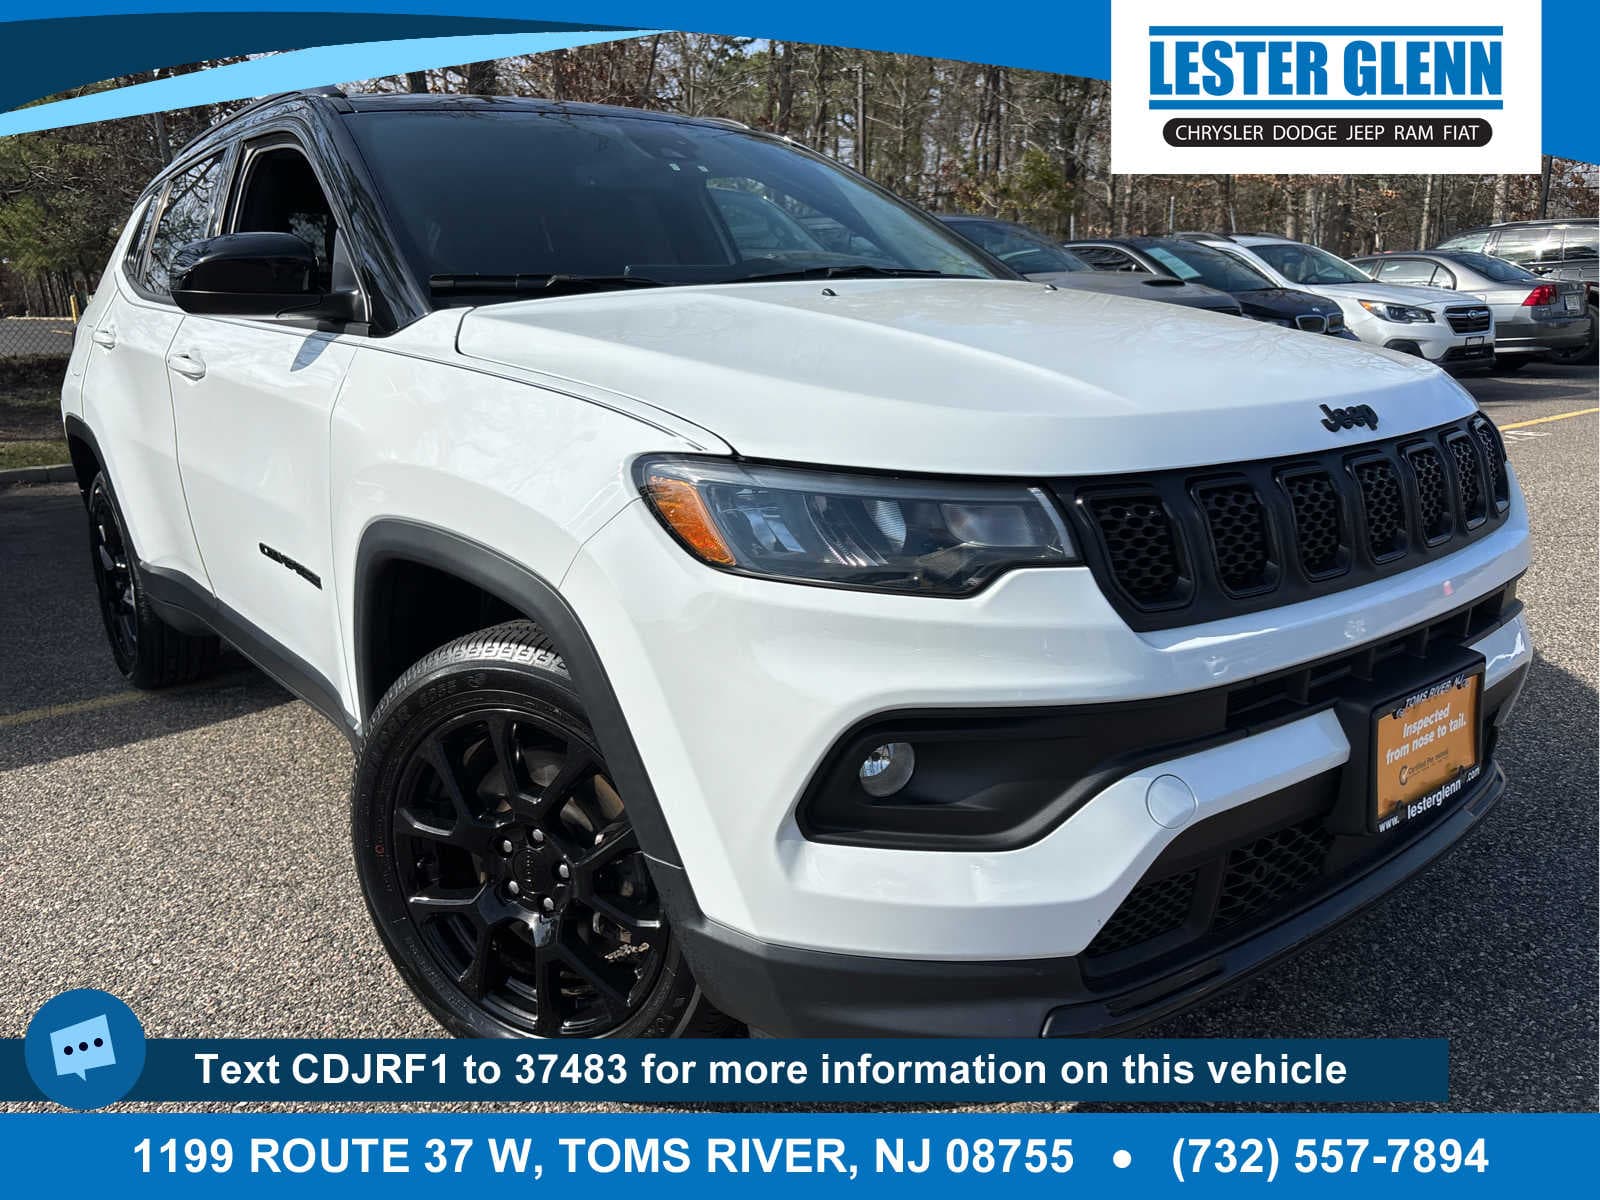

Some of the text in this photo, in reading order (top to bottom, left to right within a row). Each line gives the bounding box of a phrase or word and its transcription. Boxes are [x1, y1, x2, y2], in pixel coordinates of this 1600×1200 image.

[1319, 403, 1379, 432] Jeep
[1405, 690, 1429, 708] TOMS
[1429, 680, 1452, 698] RIVER
[1403, 703, 1451, 738] Inspected
[1386, 742, 1410, 765] from
[1412, 731, 1435, 752] nose
[1437, 725, 1447, 738] to
[1449, 712, 1467, 732] tail.
[1379, 767, 1480, 833] www. lesterglenn .com
